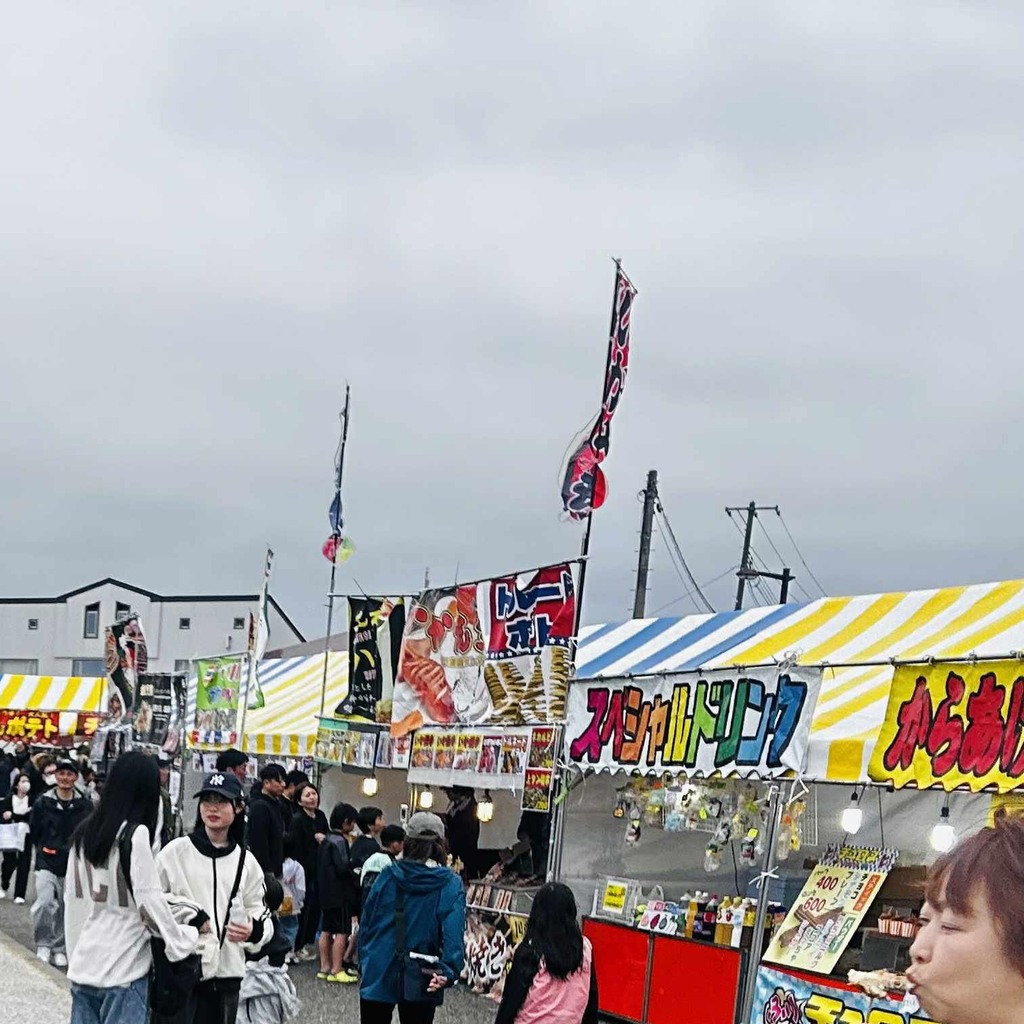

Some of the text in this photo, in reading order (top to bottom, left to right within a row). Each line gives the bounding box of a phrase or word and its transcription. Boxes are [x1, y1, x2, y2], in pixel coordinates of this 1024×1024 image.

[6, 715, 59, 739] ポテト
[570, 674, 807, 768] スペシャルドリンク
[816, 875, 838, 890] 400
[851, 873, 869, 900] チョコ
[803, 897, 827, 912] 600
